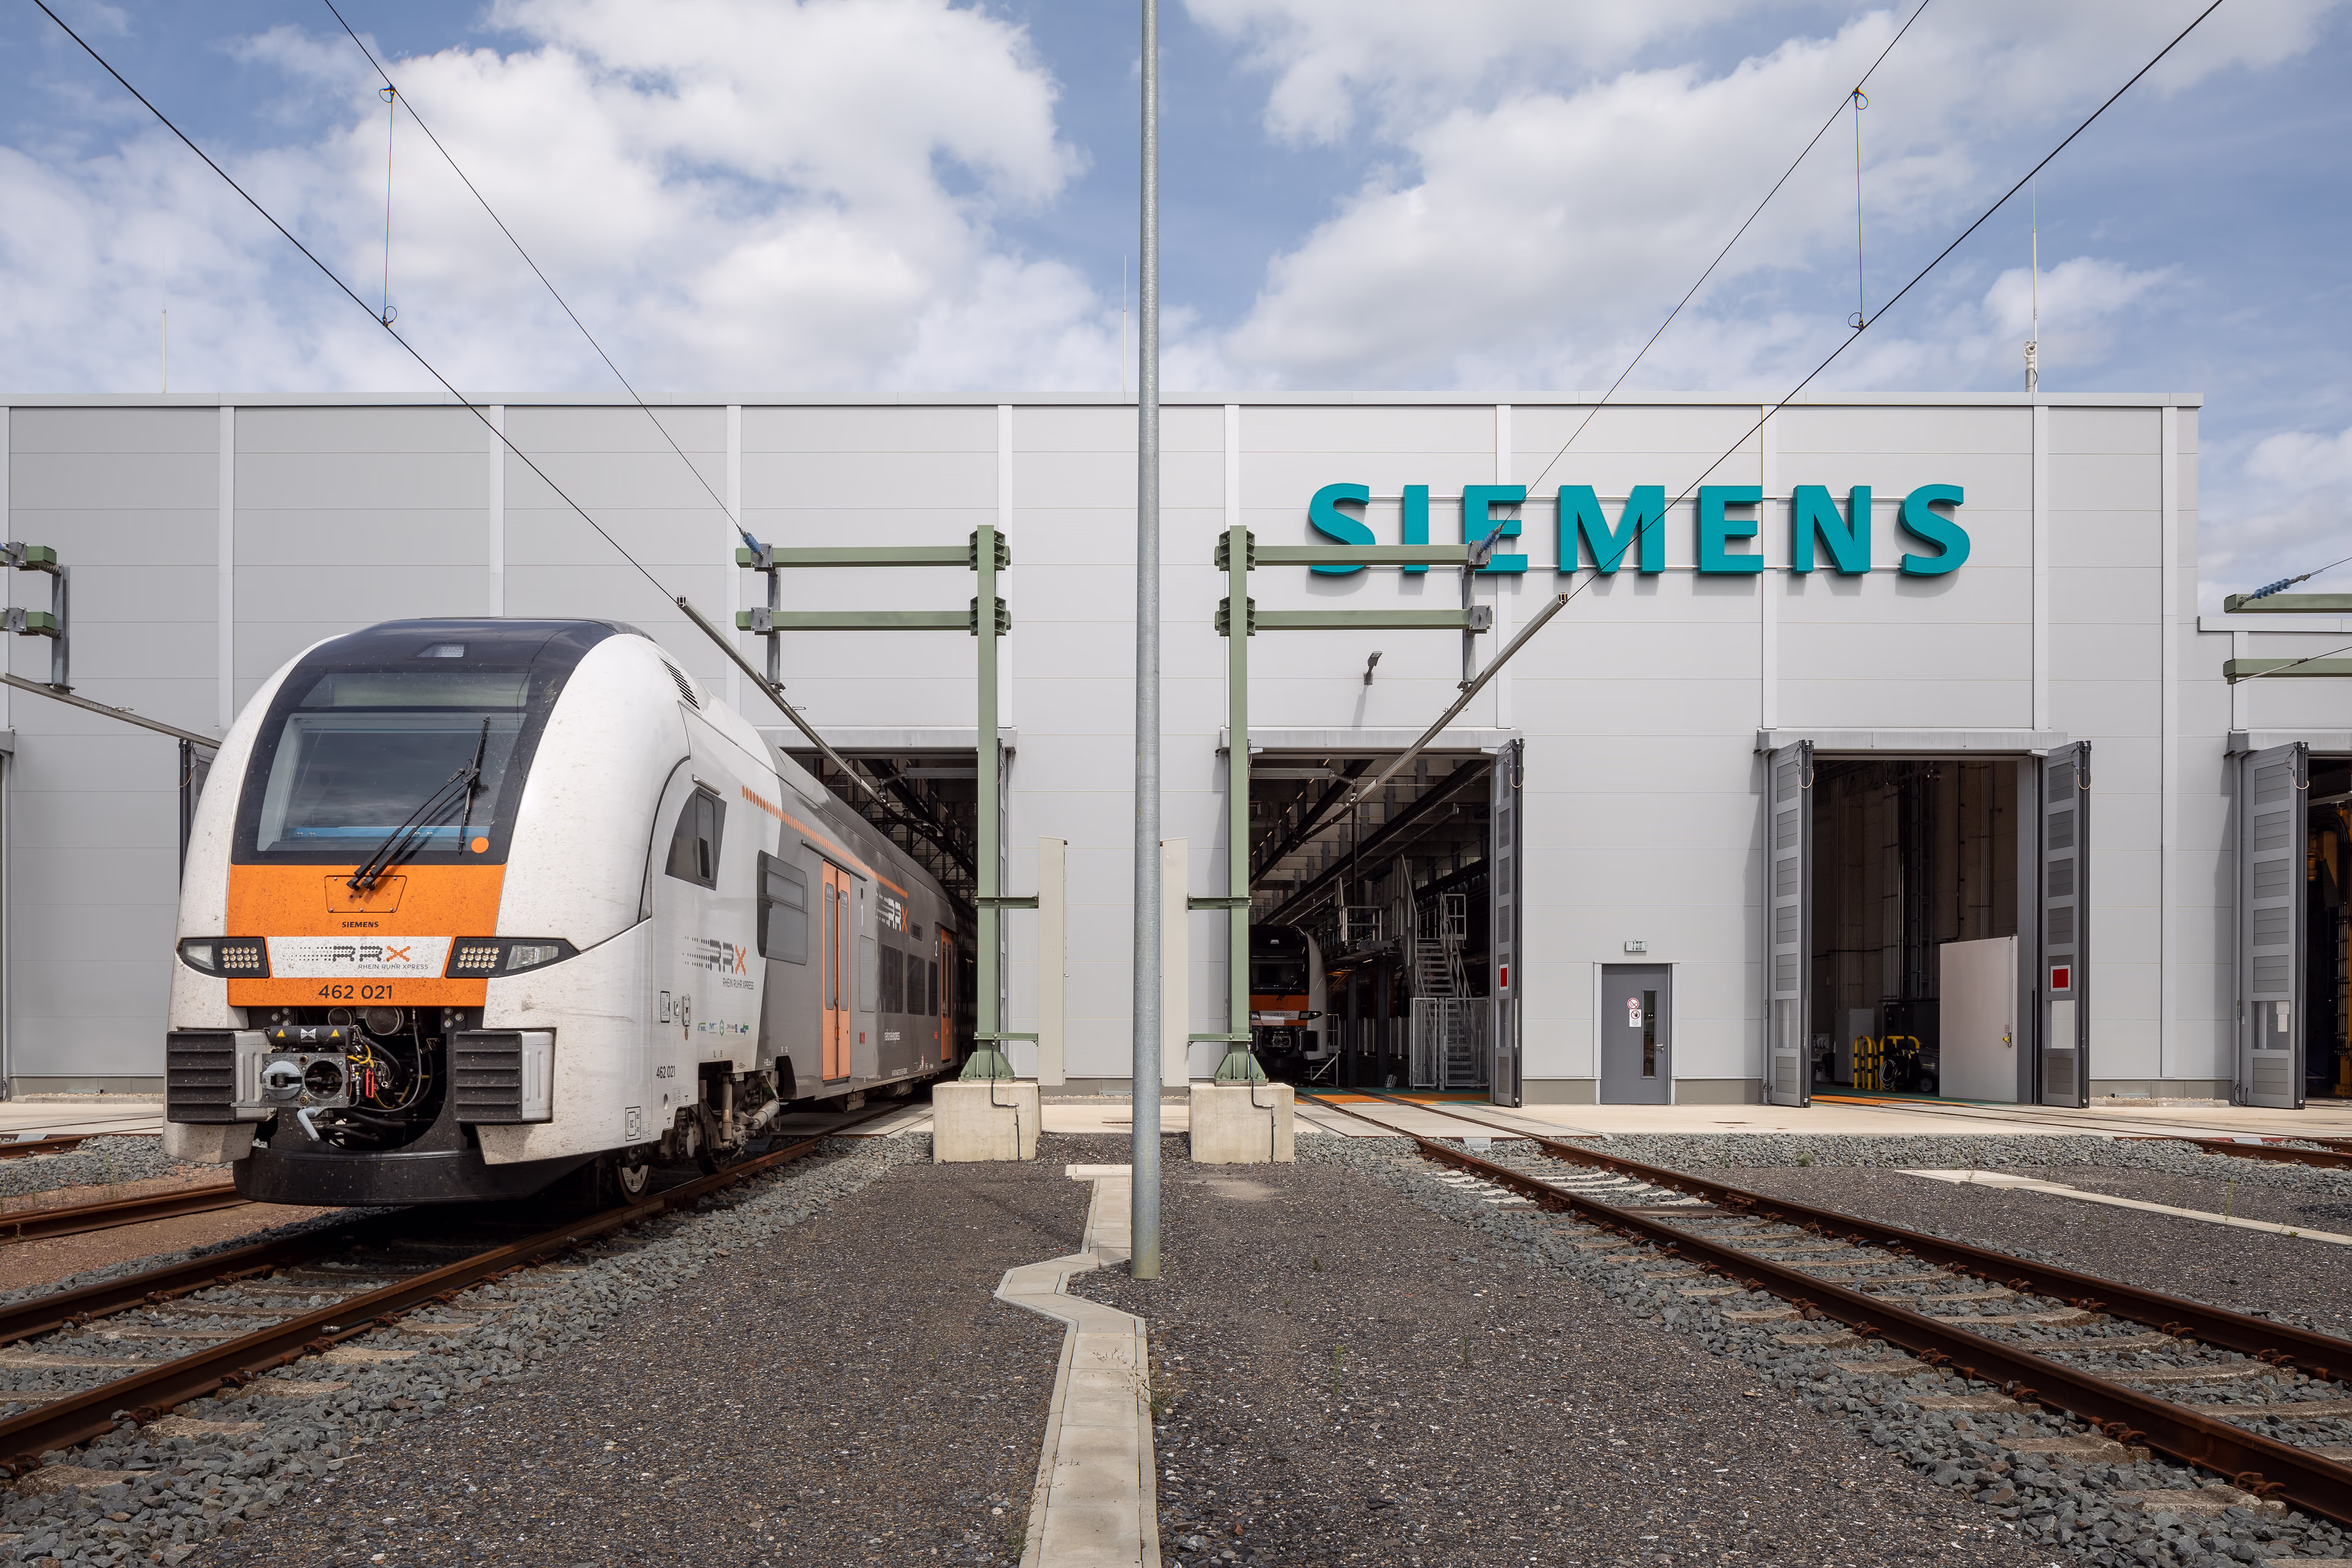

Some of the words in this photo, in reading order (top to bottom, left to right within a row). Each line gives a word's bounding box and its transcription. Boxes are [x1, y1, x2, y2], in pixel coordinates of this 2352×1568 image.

[1308, 482, 1970, 576] SIEMENS
[332, 945, 411, 962] RRX
[709, 938, 746, 976] RRX
[722, 978, 733, 988] RHEIN
[734, 979, 742, 989] RUHR
[742, 980, 754, 990] XPRESS
[318, 985, 354, 1000] 462
[361, 985, 393, 1000] 021
[656, 1066, 666, 1079] 462
[667, 1065, 676, 1078] 021
